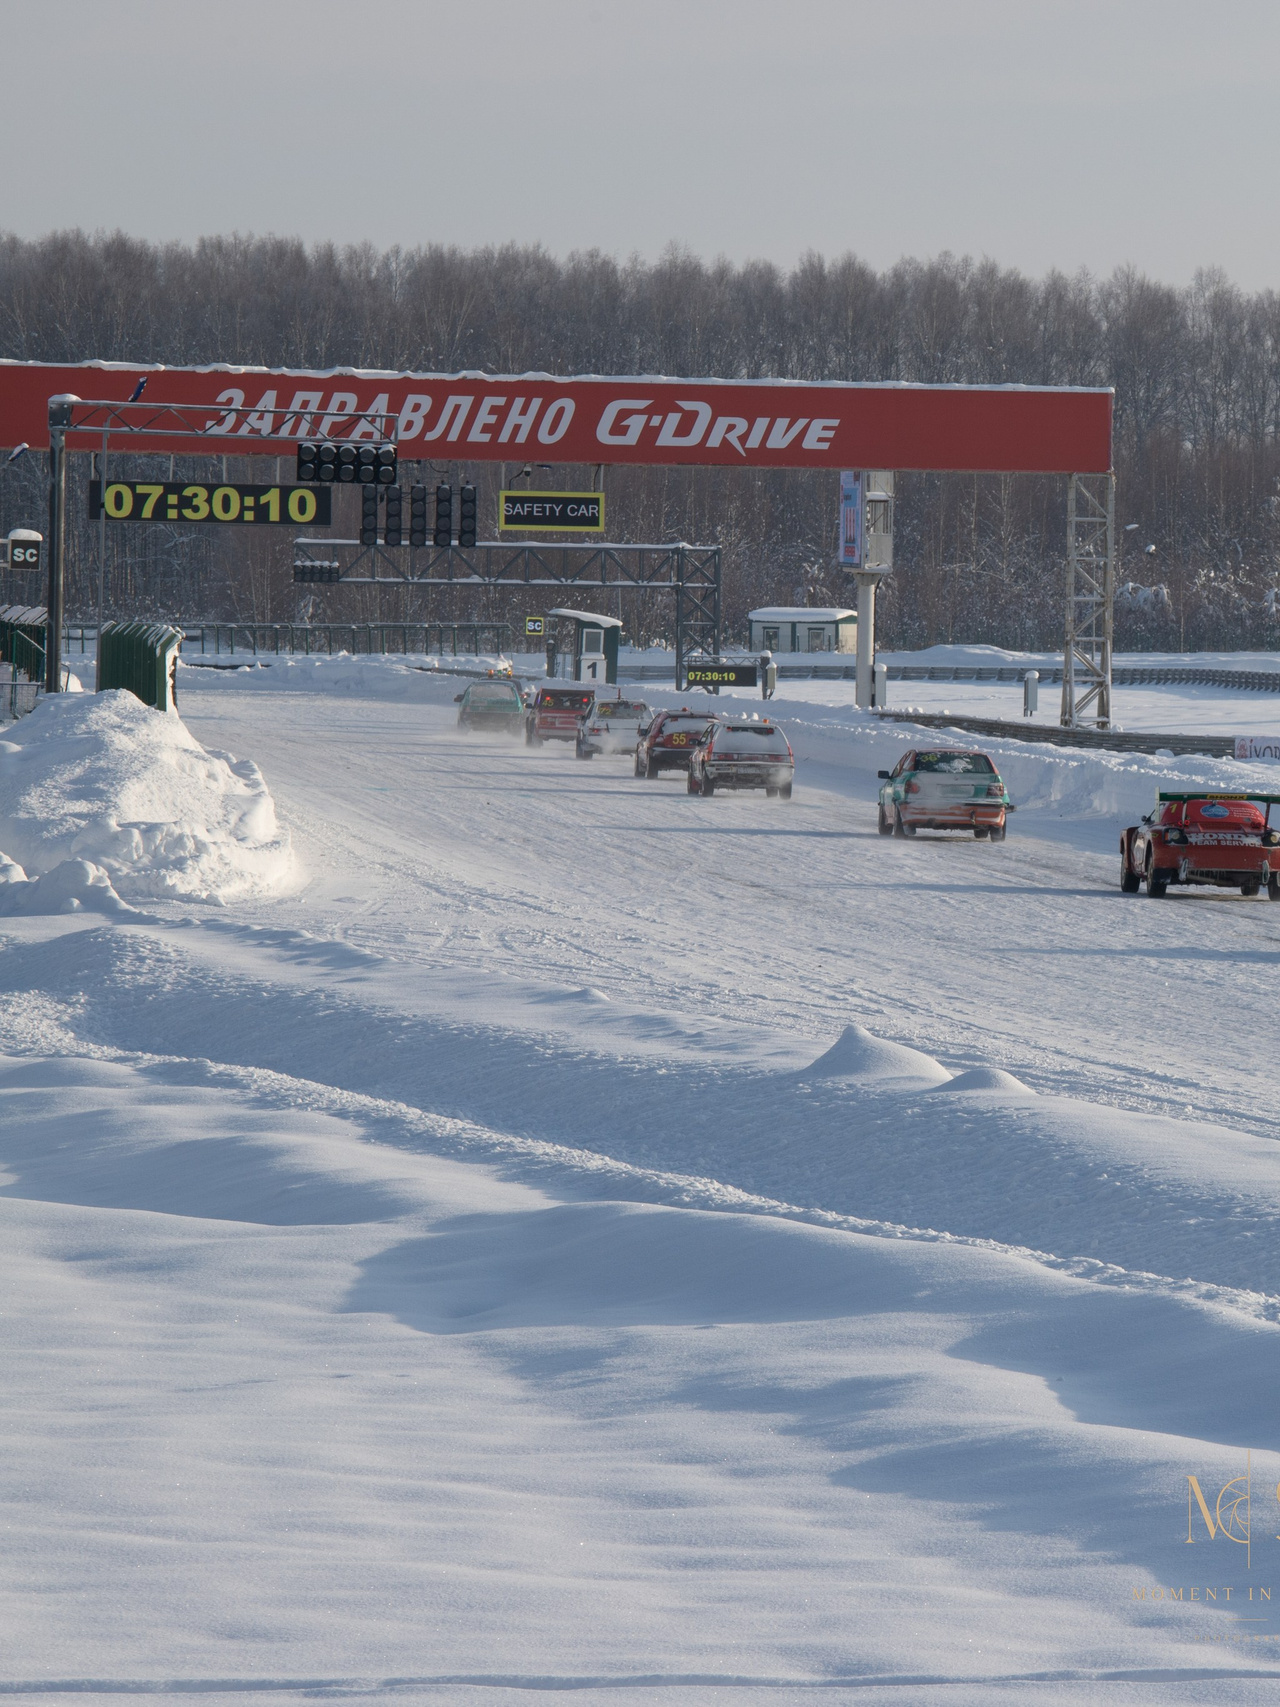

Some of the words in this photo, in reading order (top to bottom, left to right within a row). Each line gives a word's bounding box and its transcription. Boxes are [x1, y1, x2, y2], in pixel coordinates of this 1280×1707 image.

[205, 388, 576, 445] ЗАПРАВЛЕНО
[104, 484, 317, 522] 07:30:10
[504, 503, 562, 517] SAFETY
[567, 504, 599, 517] CAR
[13, 548, 37, 563] SC
[527, 621, 542, 631] SC
[587, 662, 597, 679] 1
[688, 671, 736, 682] 07:30:10
[672, 733, 686, 745] 55
[1170, 804, 1177, 814] 1
[1221, 840, 1262, 848] SERVICE
